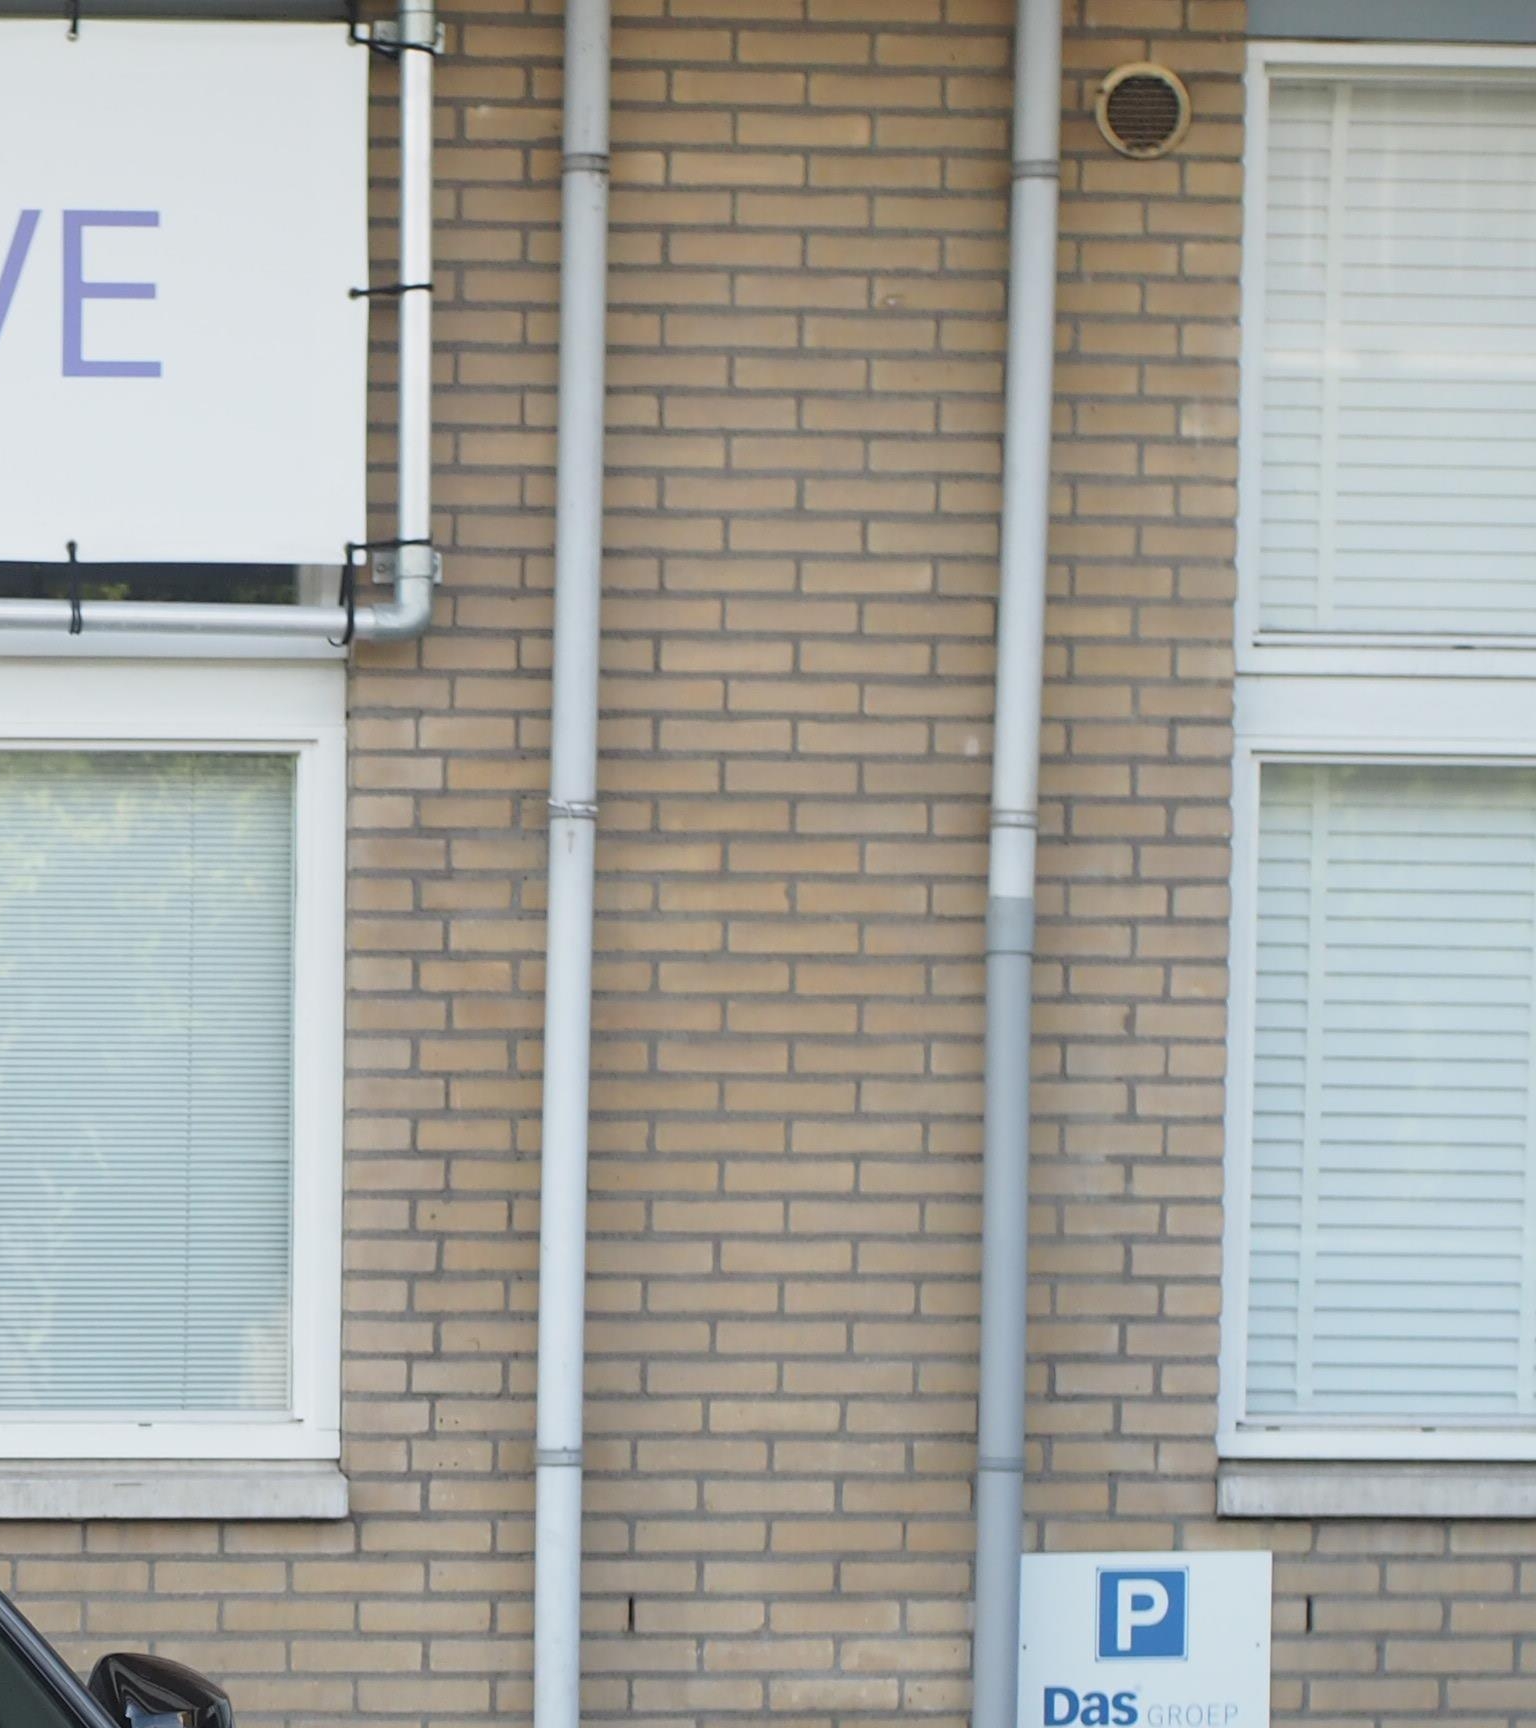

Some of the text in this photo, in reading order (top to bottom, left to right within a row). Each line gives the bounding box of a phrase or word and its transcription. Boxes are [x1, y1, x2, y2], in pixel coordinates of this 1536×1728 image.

[1116, 1578, 1170, 1651] P
[1043, 1686, 1239, 1728] Das GROEP
